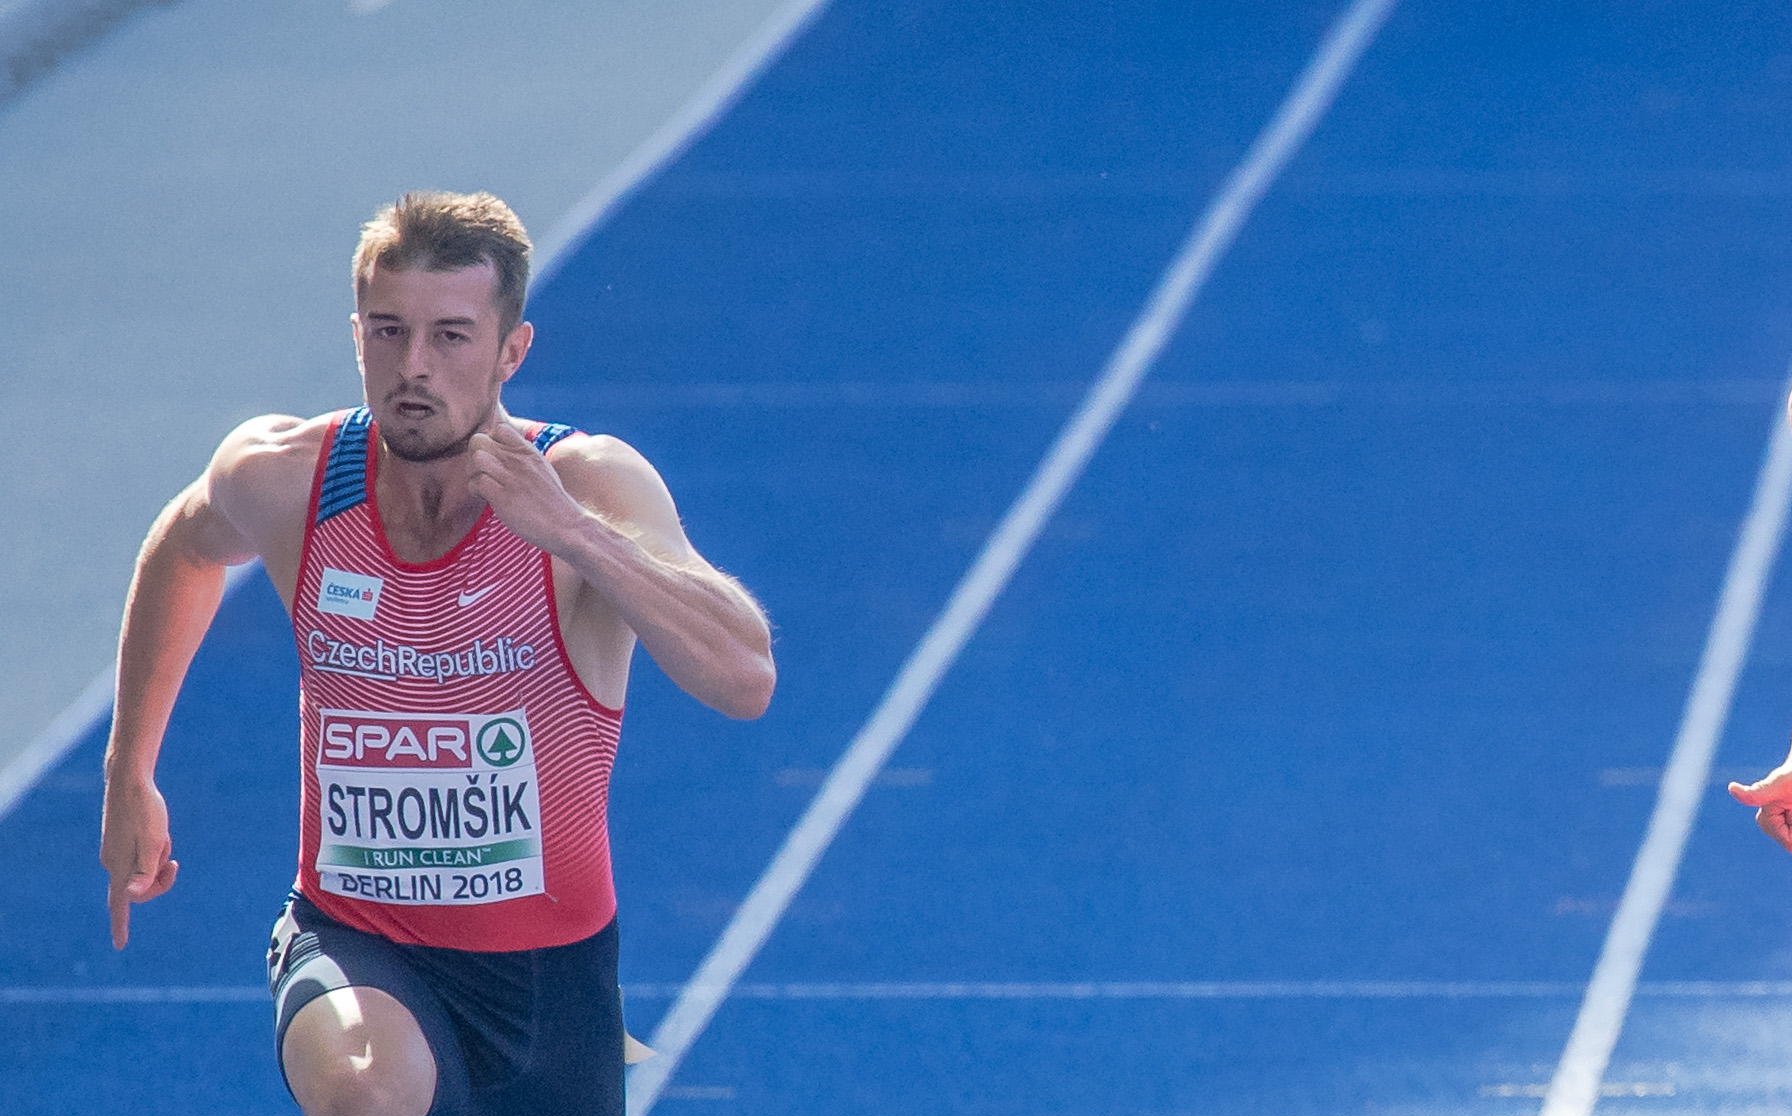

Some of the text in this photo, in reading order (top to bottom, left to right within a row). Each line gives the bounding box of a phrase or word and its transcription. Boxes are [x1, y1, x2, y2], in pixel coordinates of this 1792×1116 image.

[325, 723, 467, 762] SPAR
[328, 773, 532, 840] STROMŠÍK
[364, 850, 369, 865] I
[372, 850, 414, 866] RUN
[338, 867, 523, 901] BERLIN 2018
